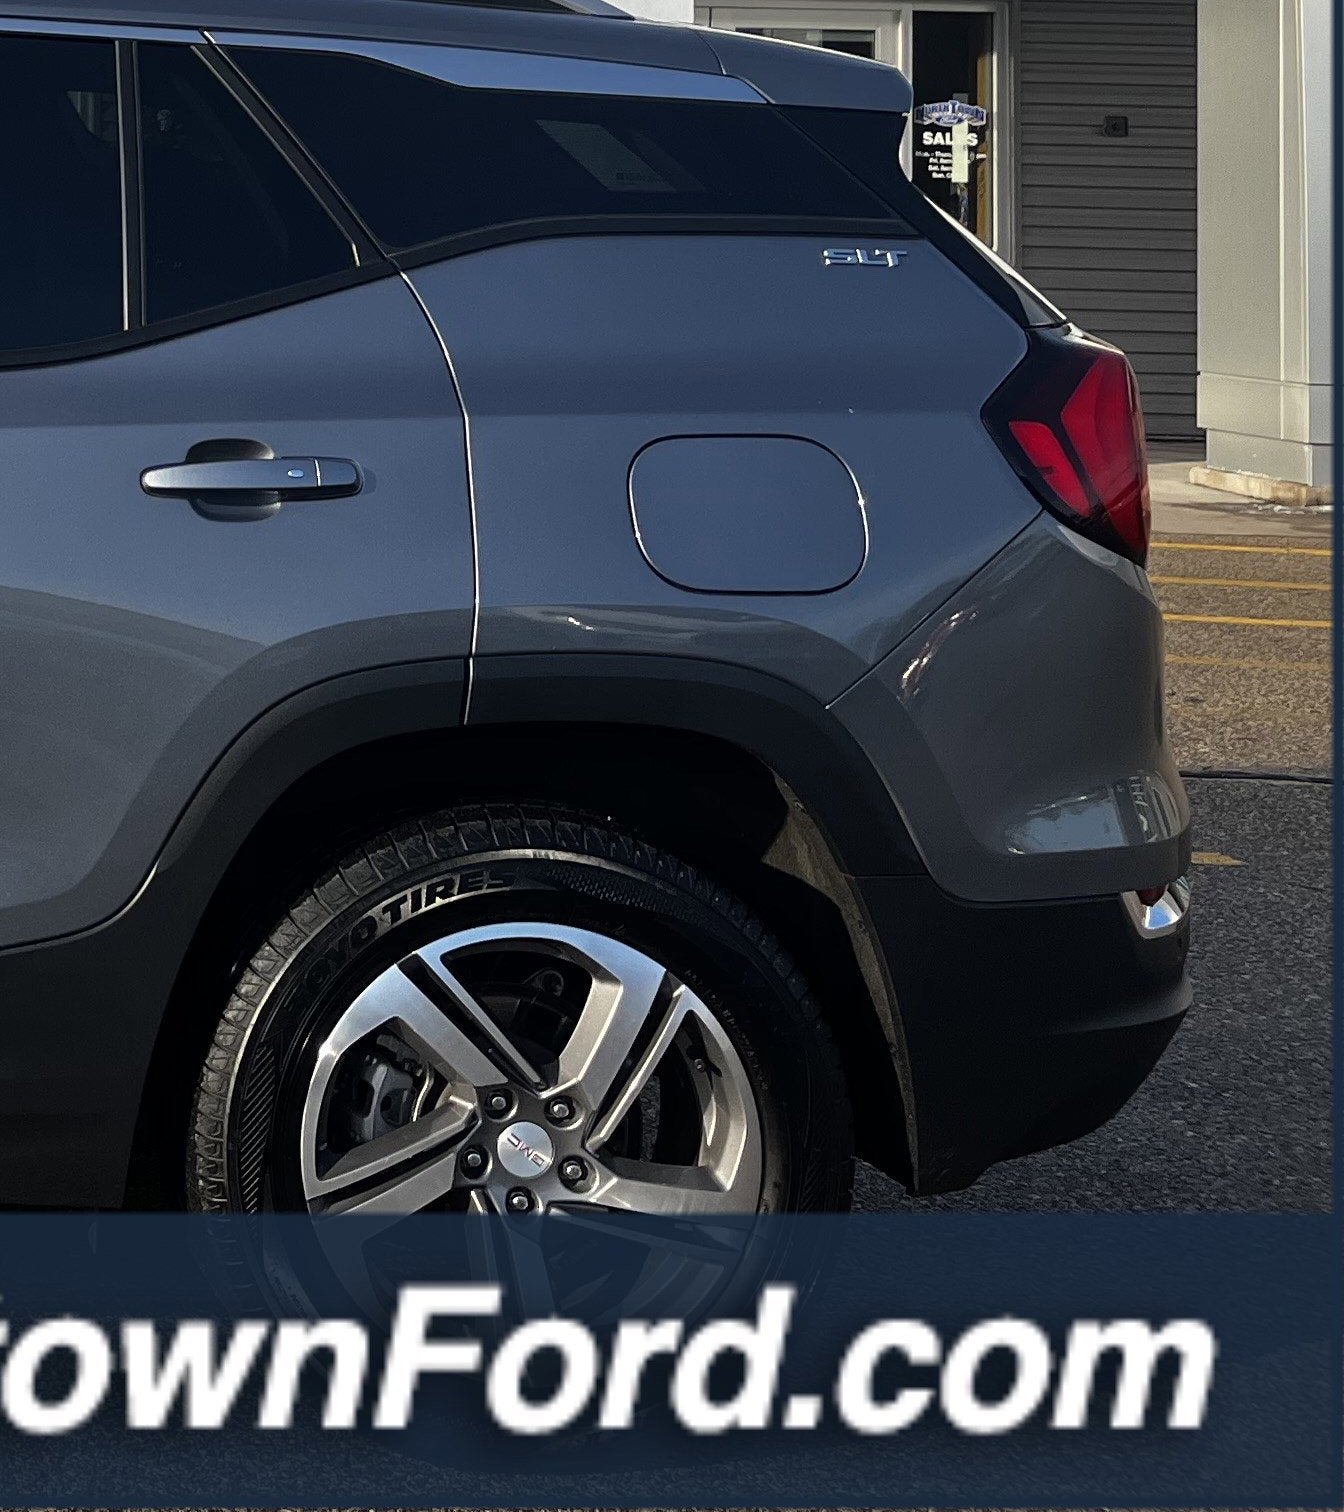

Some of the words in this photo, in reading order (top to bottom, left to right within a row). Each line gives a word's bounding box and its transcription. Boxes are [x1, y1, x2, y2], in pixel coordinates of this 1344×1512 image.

[923, 131, 978, 147] SALS
[822, 248, 908, 267] SLT
[382, 870, 515, 924] TIRES
[507, 1132, 546, 1167] GMC
